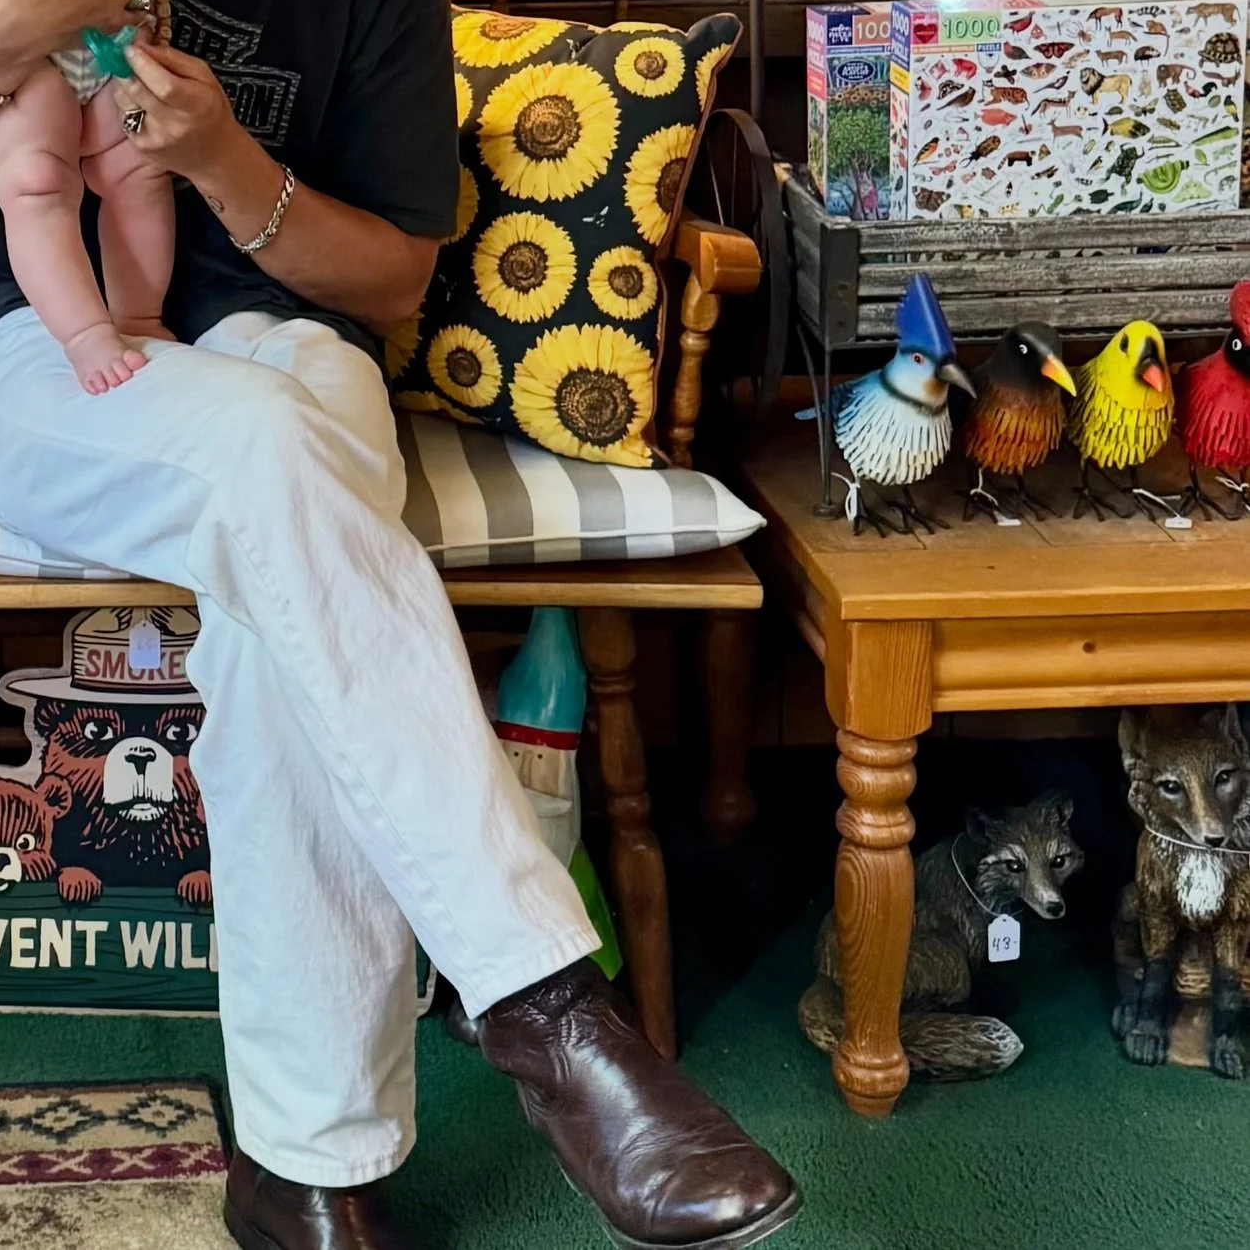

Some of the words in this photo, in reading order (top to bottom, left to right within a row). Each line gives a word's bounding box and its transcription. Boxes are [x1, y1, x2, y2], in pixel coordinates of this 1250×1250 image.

[856, 21, 890, 40] 100
[943, 16, 1000, 39] 1000
[85, 648, 189, 681] SMKE
[120, 920, 219, 972] WIL
